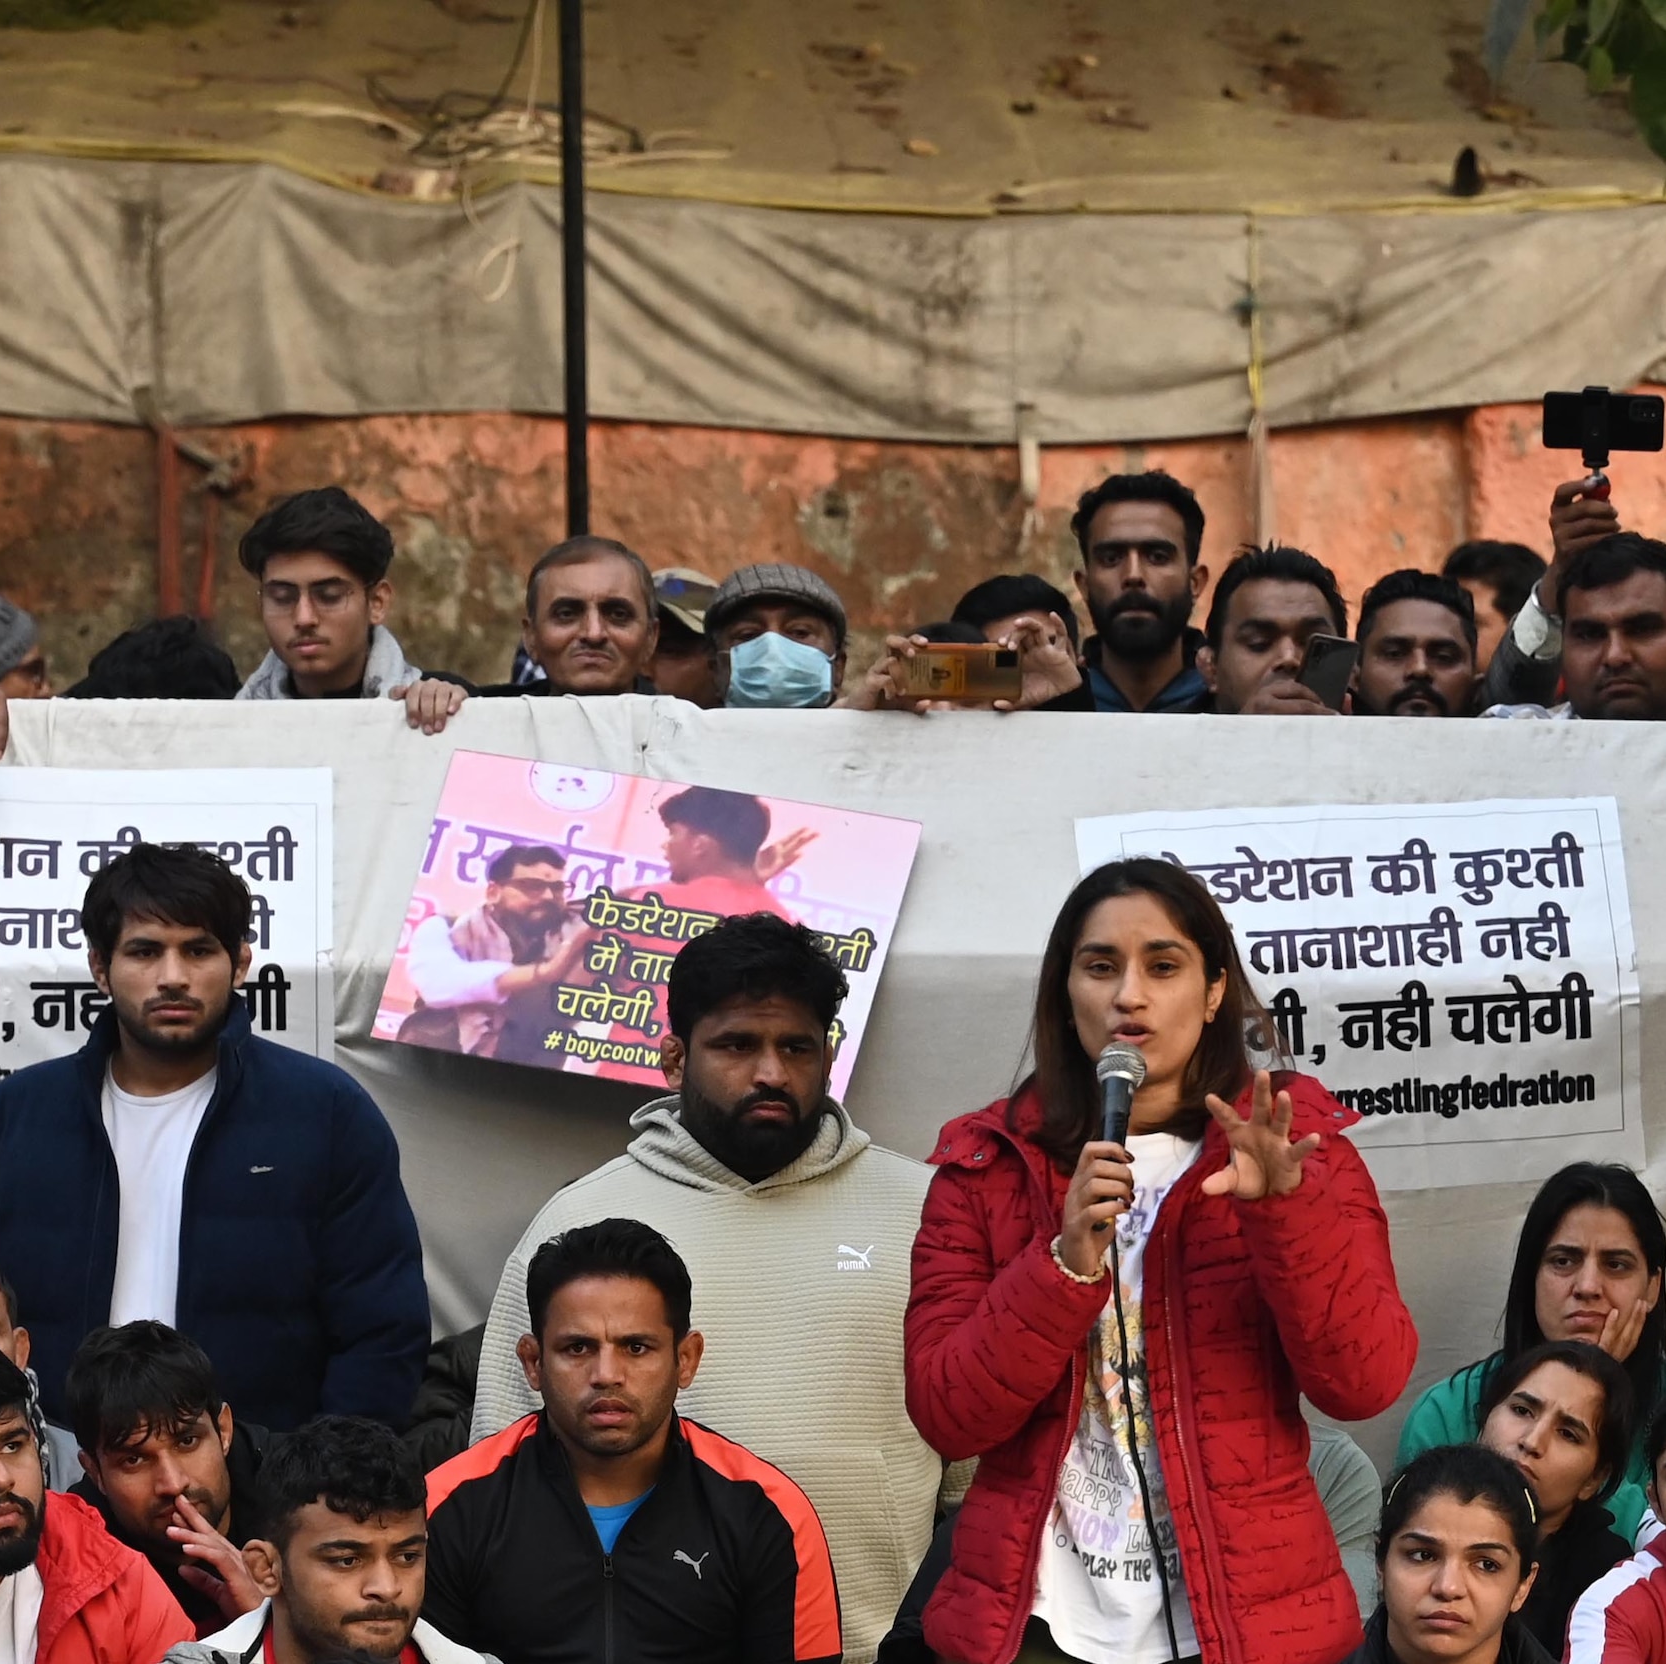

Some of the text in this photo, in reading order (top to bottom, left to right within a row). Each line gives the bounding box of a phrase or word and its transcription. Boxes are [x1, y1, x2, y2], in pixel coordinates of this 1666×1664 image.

[1366, 837, 1437, 897] की
[1449, 831, 1585, 906] कुश्ती
[1246, 900, 1571, 976] तानाशाही नही
[1337, 980, 1435, 1054] नही
[1445, 970, 1595, 1045] चलेगी
